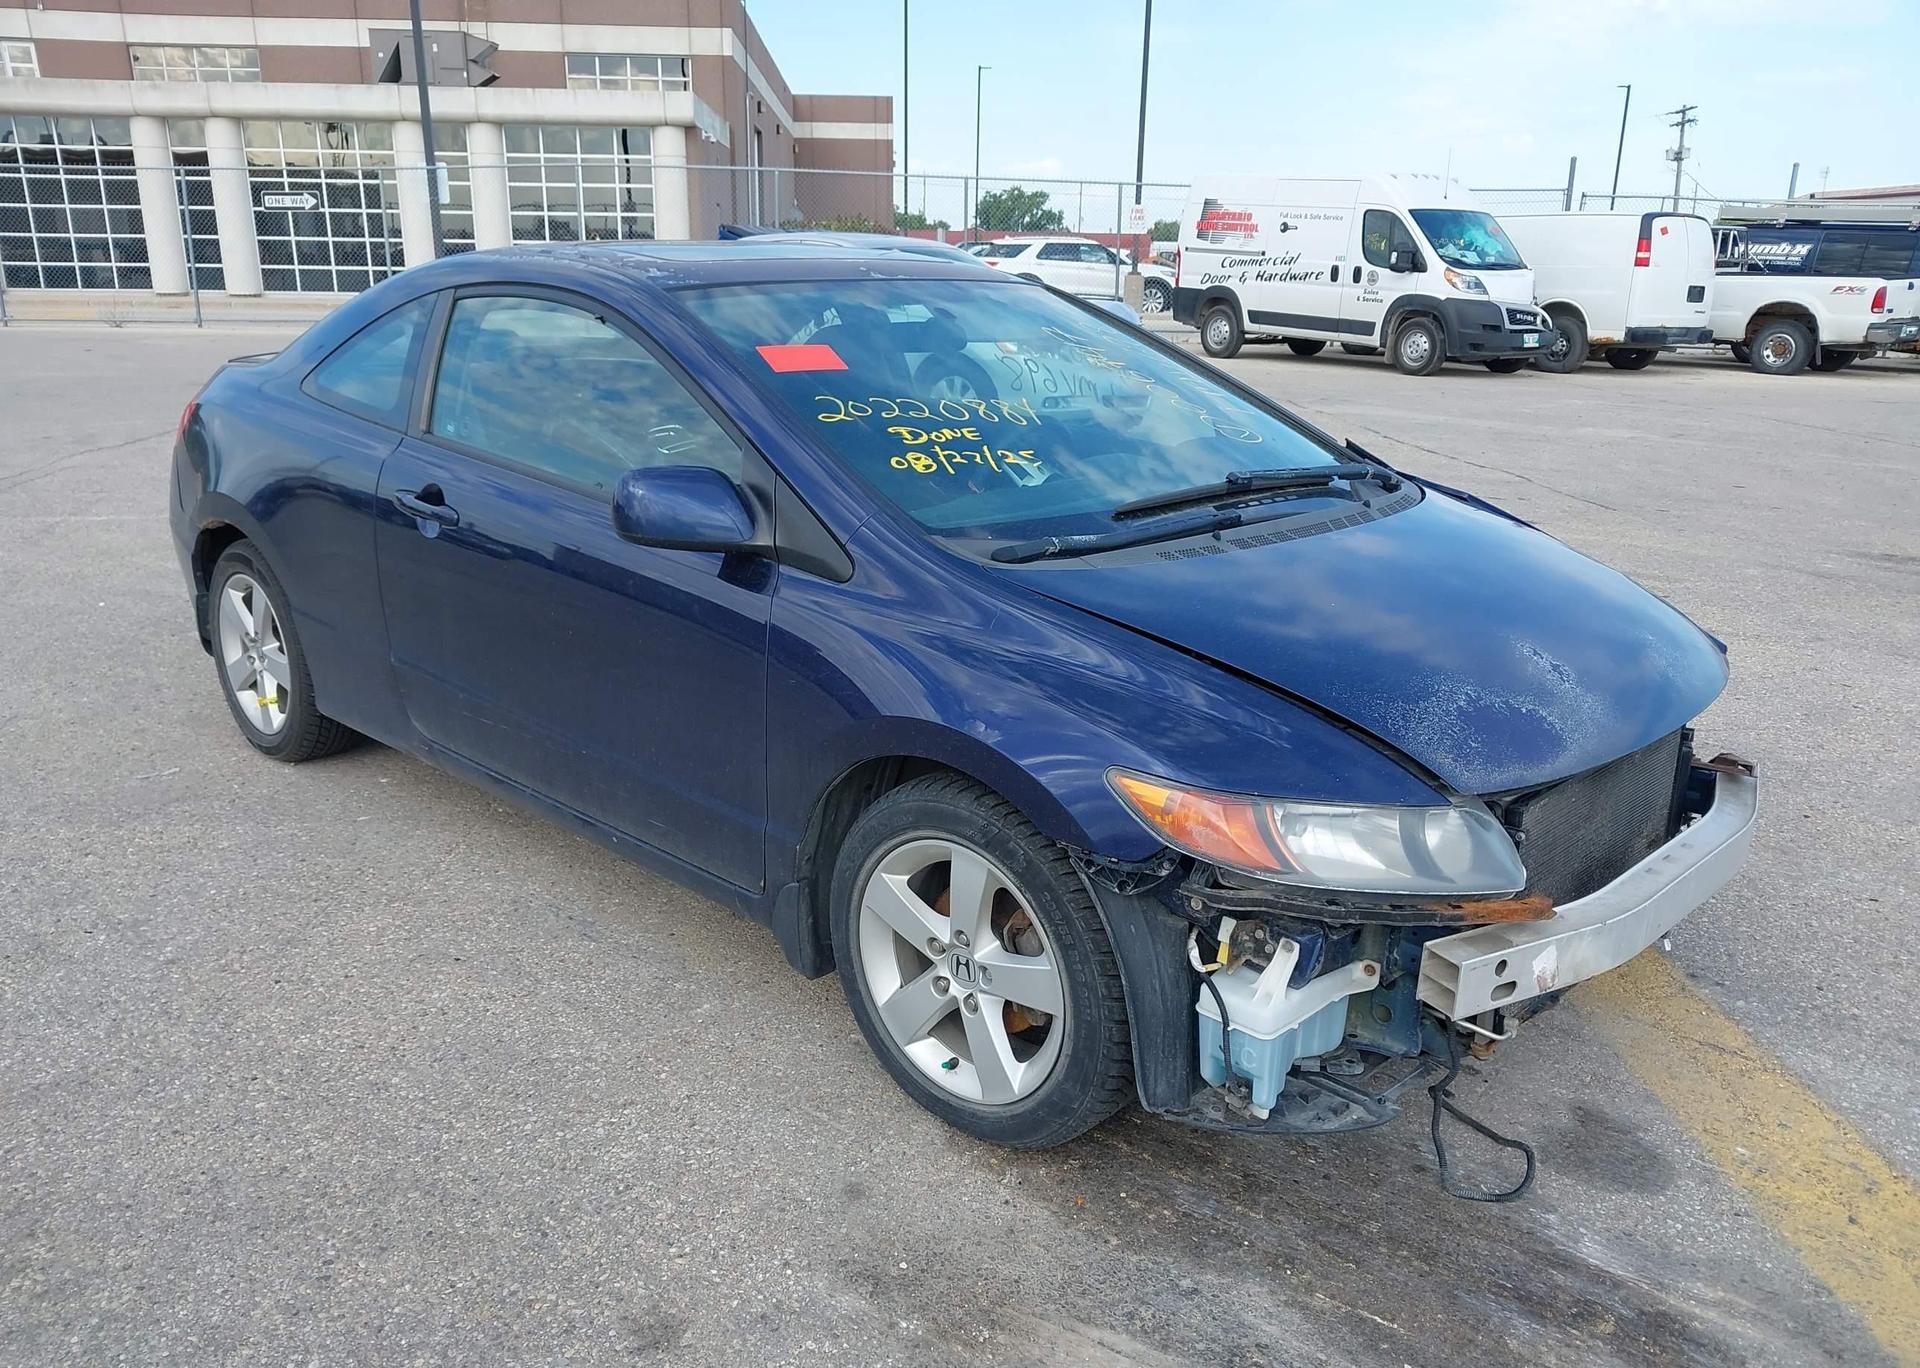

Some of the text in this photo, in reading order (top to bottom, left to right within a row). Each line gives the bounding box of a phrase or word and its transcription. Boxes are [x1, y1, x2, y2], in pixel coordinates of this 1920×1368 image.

[267, 197, 310, 205] ONE WAY
[1221, 250, 1302, 268] Commercial
[1200, 267, 1325, 285] Door & Hardware
